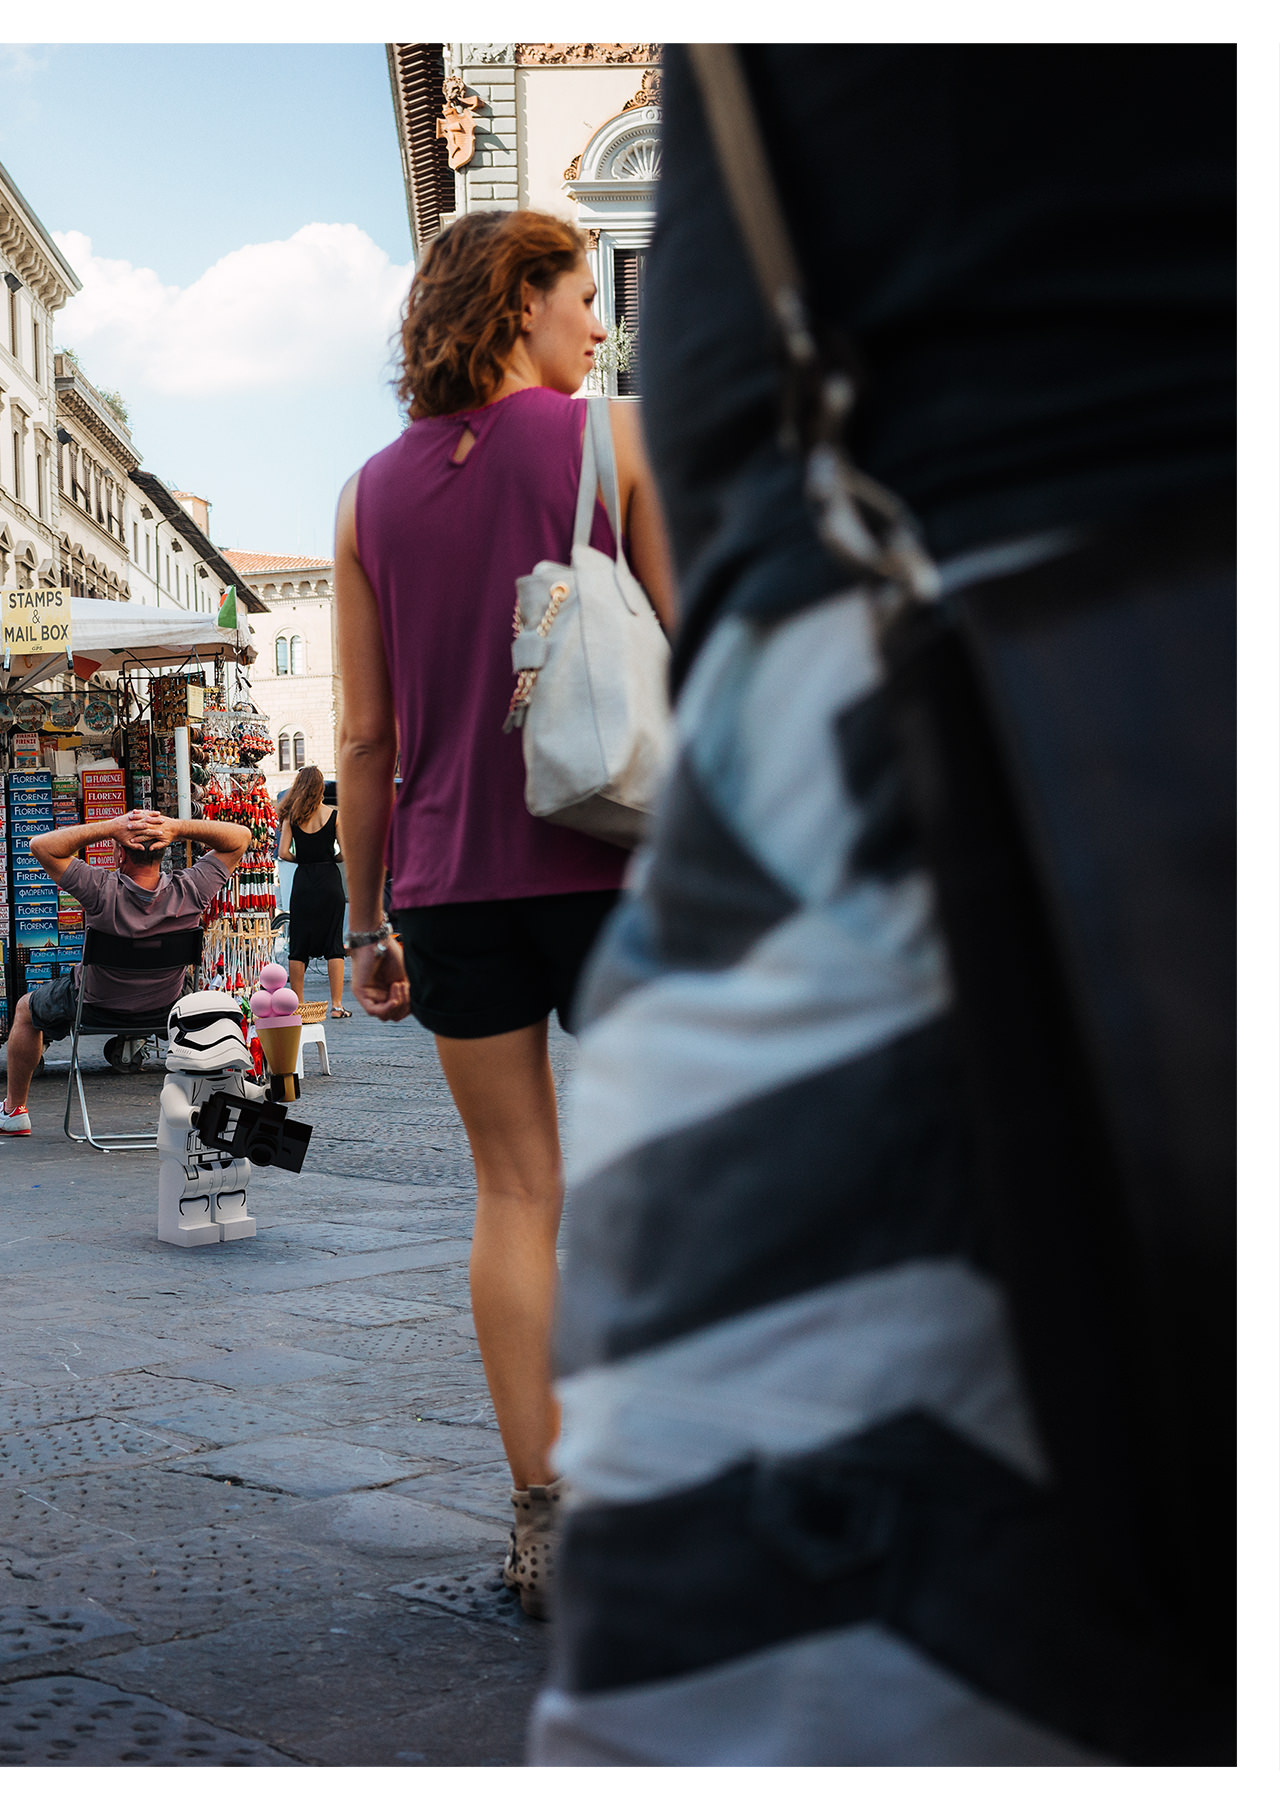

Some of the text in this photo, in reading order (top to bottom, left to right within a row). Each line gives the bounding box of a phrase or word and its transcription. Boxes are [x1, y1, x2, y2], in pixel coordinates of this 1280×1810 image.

[9, 590, 63, 609] STAMPS
[32, 609, 40, 624] &
[4, 624, 69, 643] MAIL BOX
[12, 774, 48, 784] FLORENCE
[93, 774, 121, 783] FLORENCE
[13, 792, 48, 801] FLORENZ
[88, 792, 122, 800] FLORENZ
[14, 806, 49, 816] FLORENCE
[95, 807, 124, 816] FLORENCIA
[14, 823, 50, 833] FLORENCIA
[96, 840, 113, 848] FIRE
[16, 872, 52, 881] FIRENZE
[17, 906, 53, 915] FLORENCE
[19, 921, 54, 931] FLORENÇA
